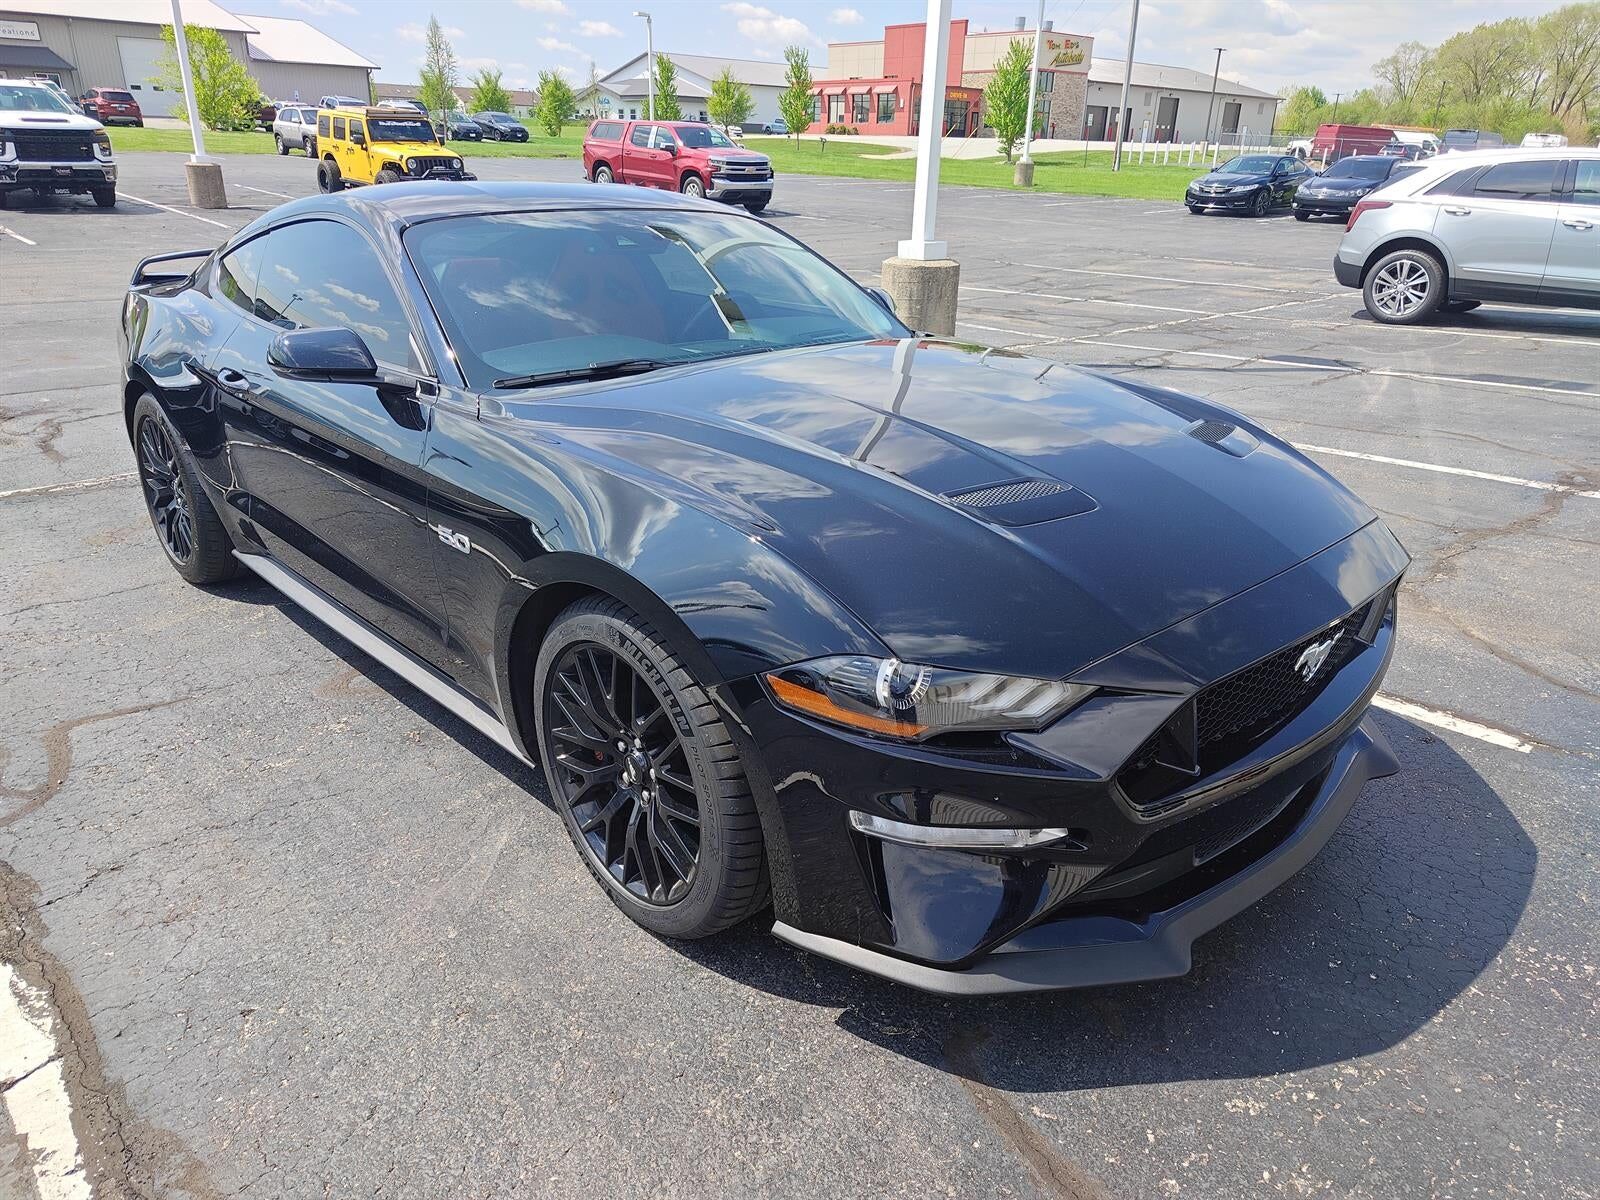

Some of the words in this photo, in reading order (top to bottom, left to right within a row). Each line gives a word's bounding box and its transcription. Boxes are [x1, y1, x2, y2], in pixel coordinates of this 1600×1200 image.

[622, 640, 690, 731] MICHELIN
[691, 745, 706, 781] PILOT
[703, 783, 715, 823] SPORT
